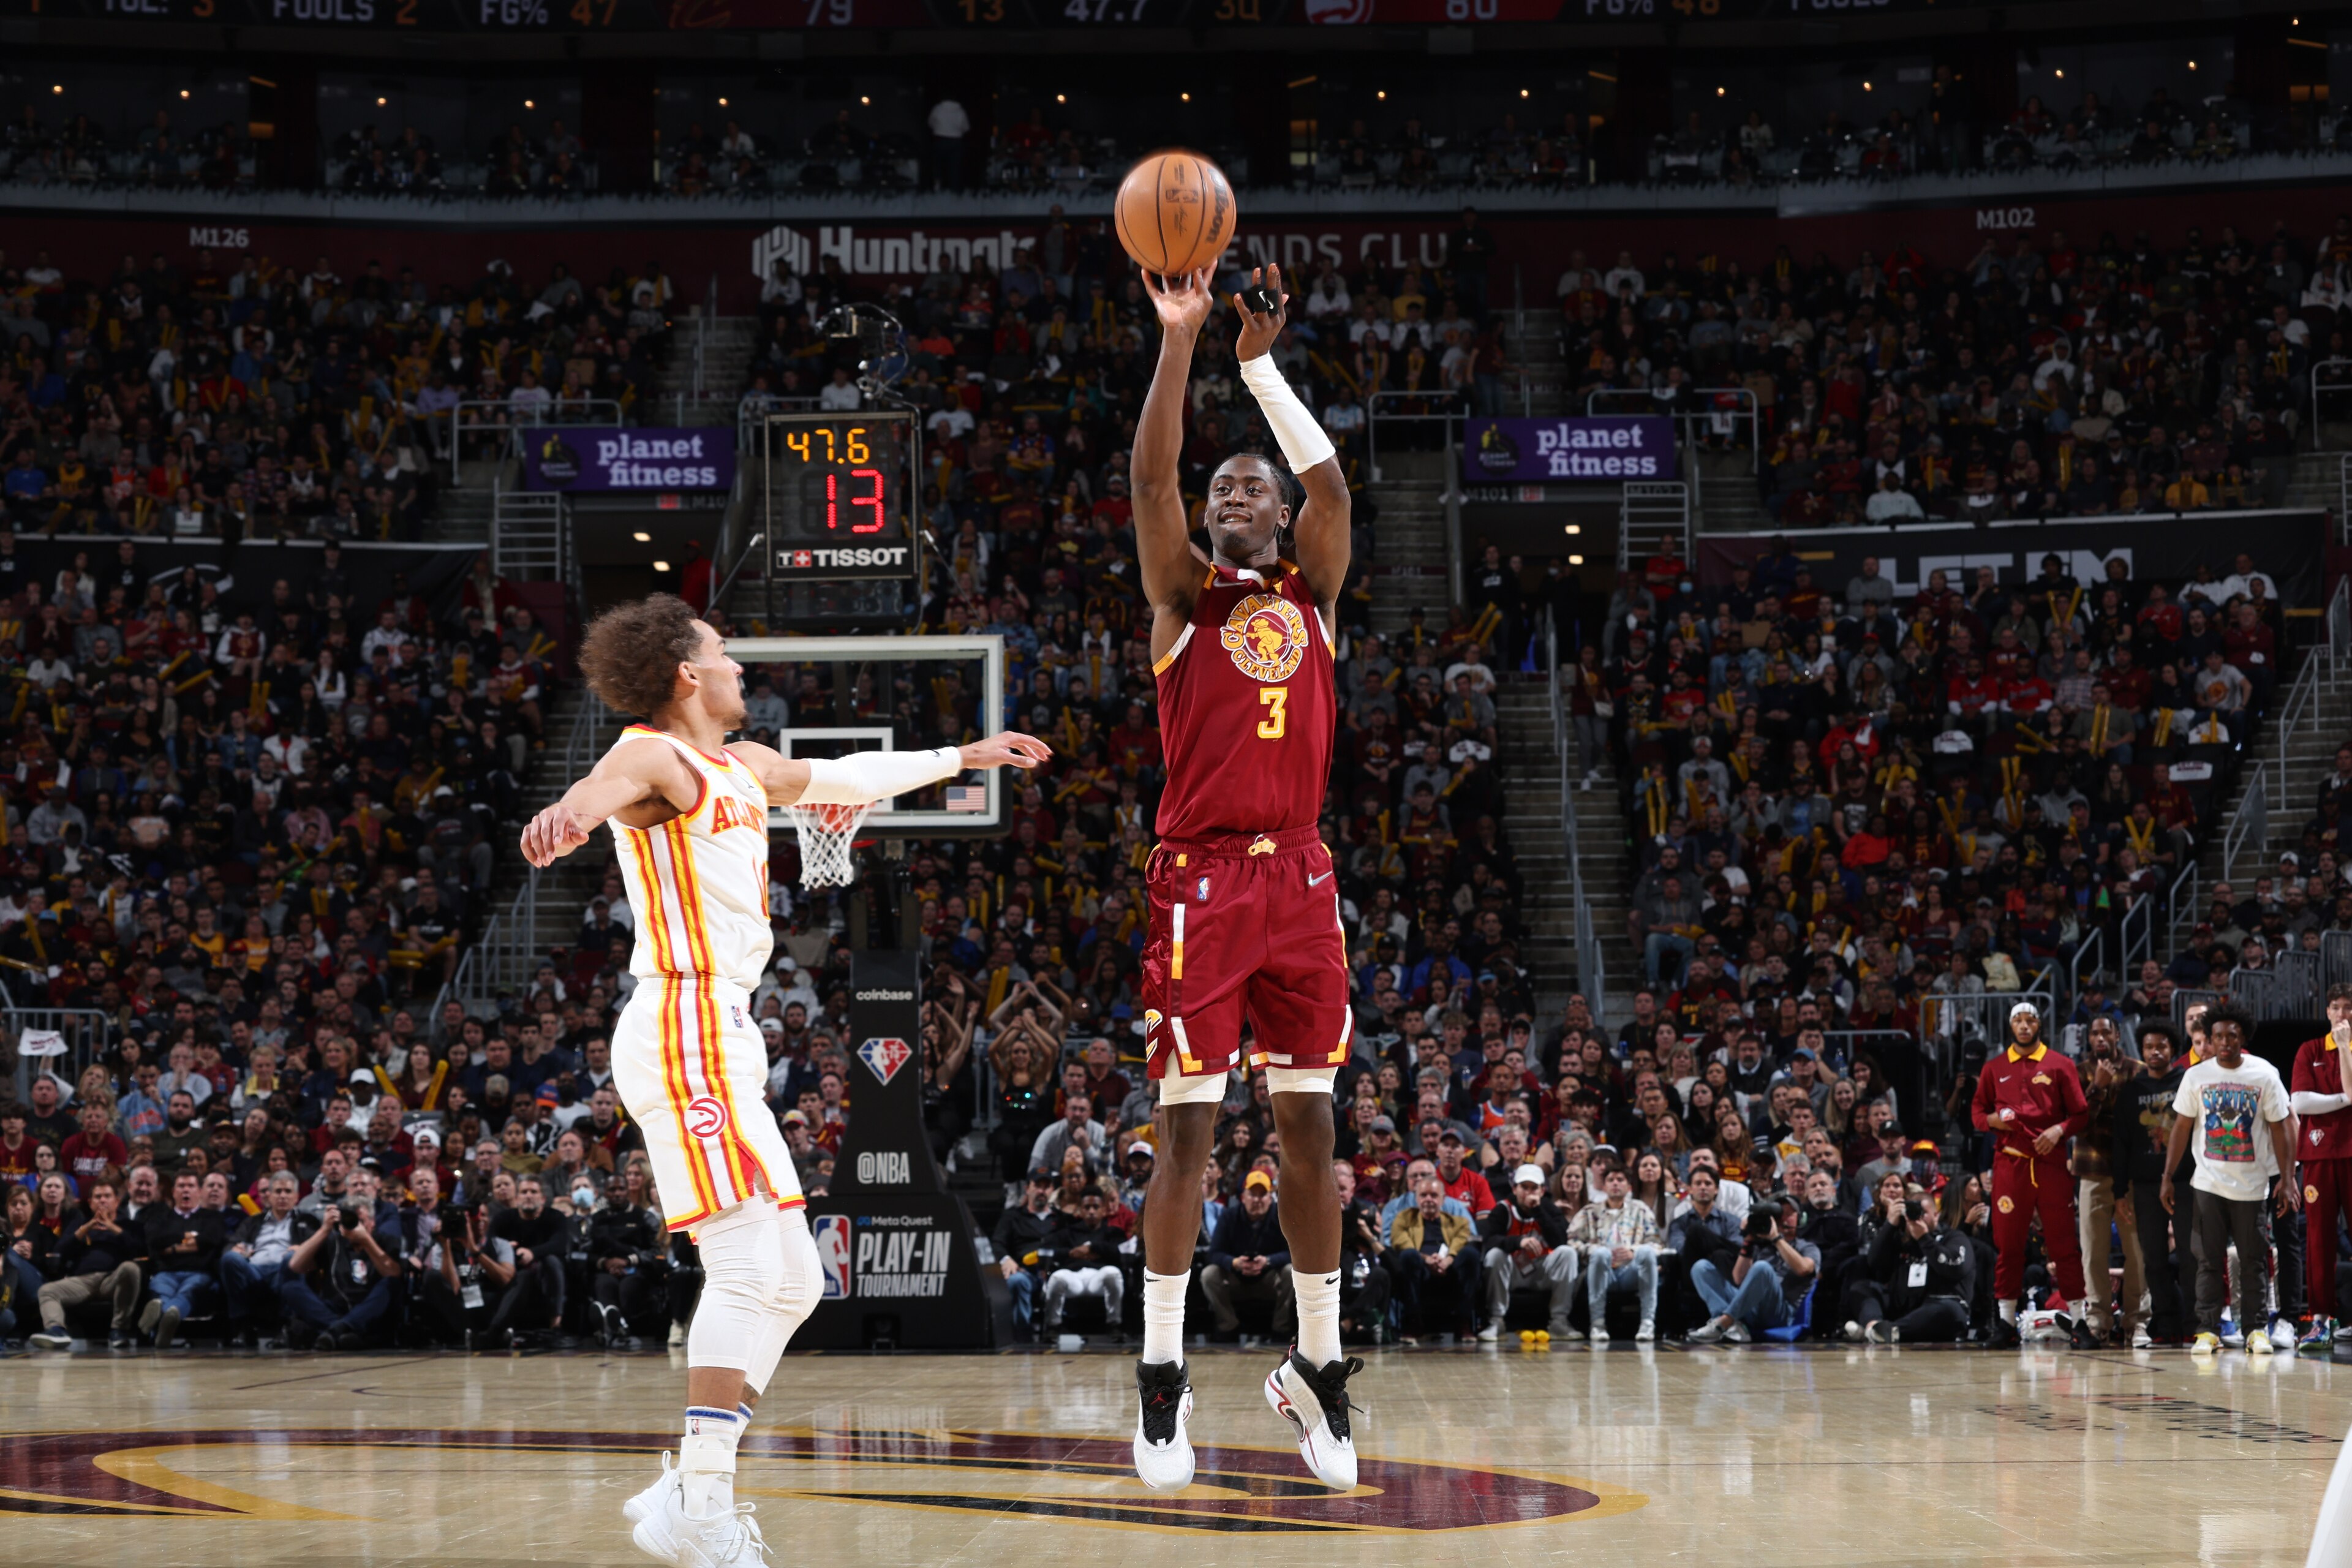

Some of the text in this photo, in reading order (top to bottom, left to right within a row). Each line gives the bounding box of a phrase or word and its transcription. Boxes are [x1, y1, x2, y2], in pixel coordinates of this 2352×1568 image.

[396, 0, 418, 24] 2
[480, 0, 618, 25] FG% 47
[803, 0, 853, 25] 79
[958, 0, 1005, 22] 13
[1976, 207, 2035, 230] M102
[189, 227, 249, 248] M126
[1359, 232, 1448, 269] CLU
[597, 433, 704, 466] planet
[787, 428, 869, 464] 47.6
[1536, 423, 1643, 454] planet
[608, 461, 717, 486] fitness
[1548, 451, 1657, 476] fitness
[826, 469, 885, 533] 13
[813, 548, 908, 567] TISSOT
[1879, 552, 2013, 597] LET
[1222, 594, 1308, 649] CAVALIERS
[1232, 648, 1302, 681] CLEVELAND
[1257, 687, 1287, 739] 3
[856, 988, 913, 1001] coinbase
[857, 1152, 910, 1185] @NBA
[872, 1216, 933, 1227] Meta Quest
[856, 1231, 951, 1273] PLAY-IN
[856, 1273, 947, 1297] TOURNAMENT
